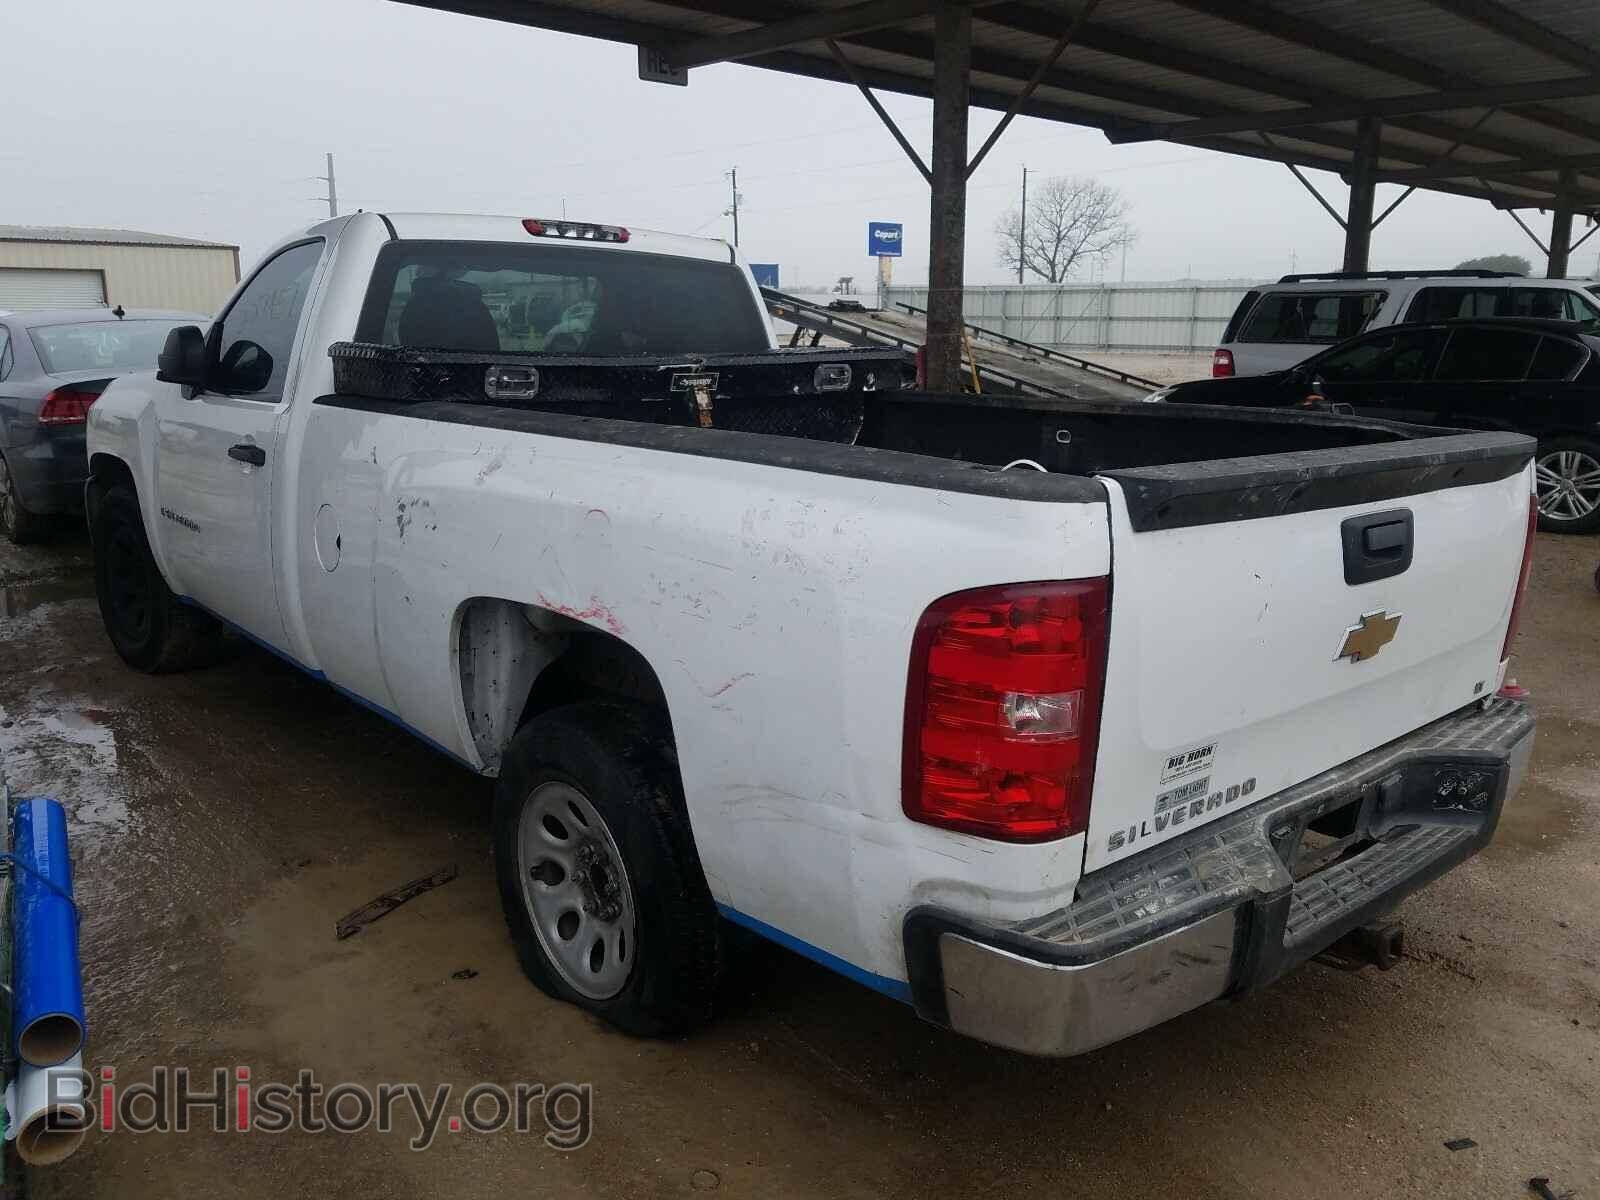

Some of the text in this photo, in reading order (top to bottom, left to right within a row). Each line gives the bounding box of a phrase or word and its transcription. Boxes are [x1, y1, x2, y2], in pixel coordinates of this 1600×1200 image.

[1168, 755, 1186, 769] BIG
[1187, 746, 1213, 763] HORN
[1107, 778, 1257, 852] SILVERADO
